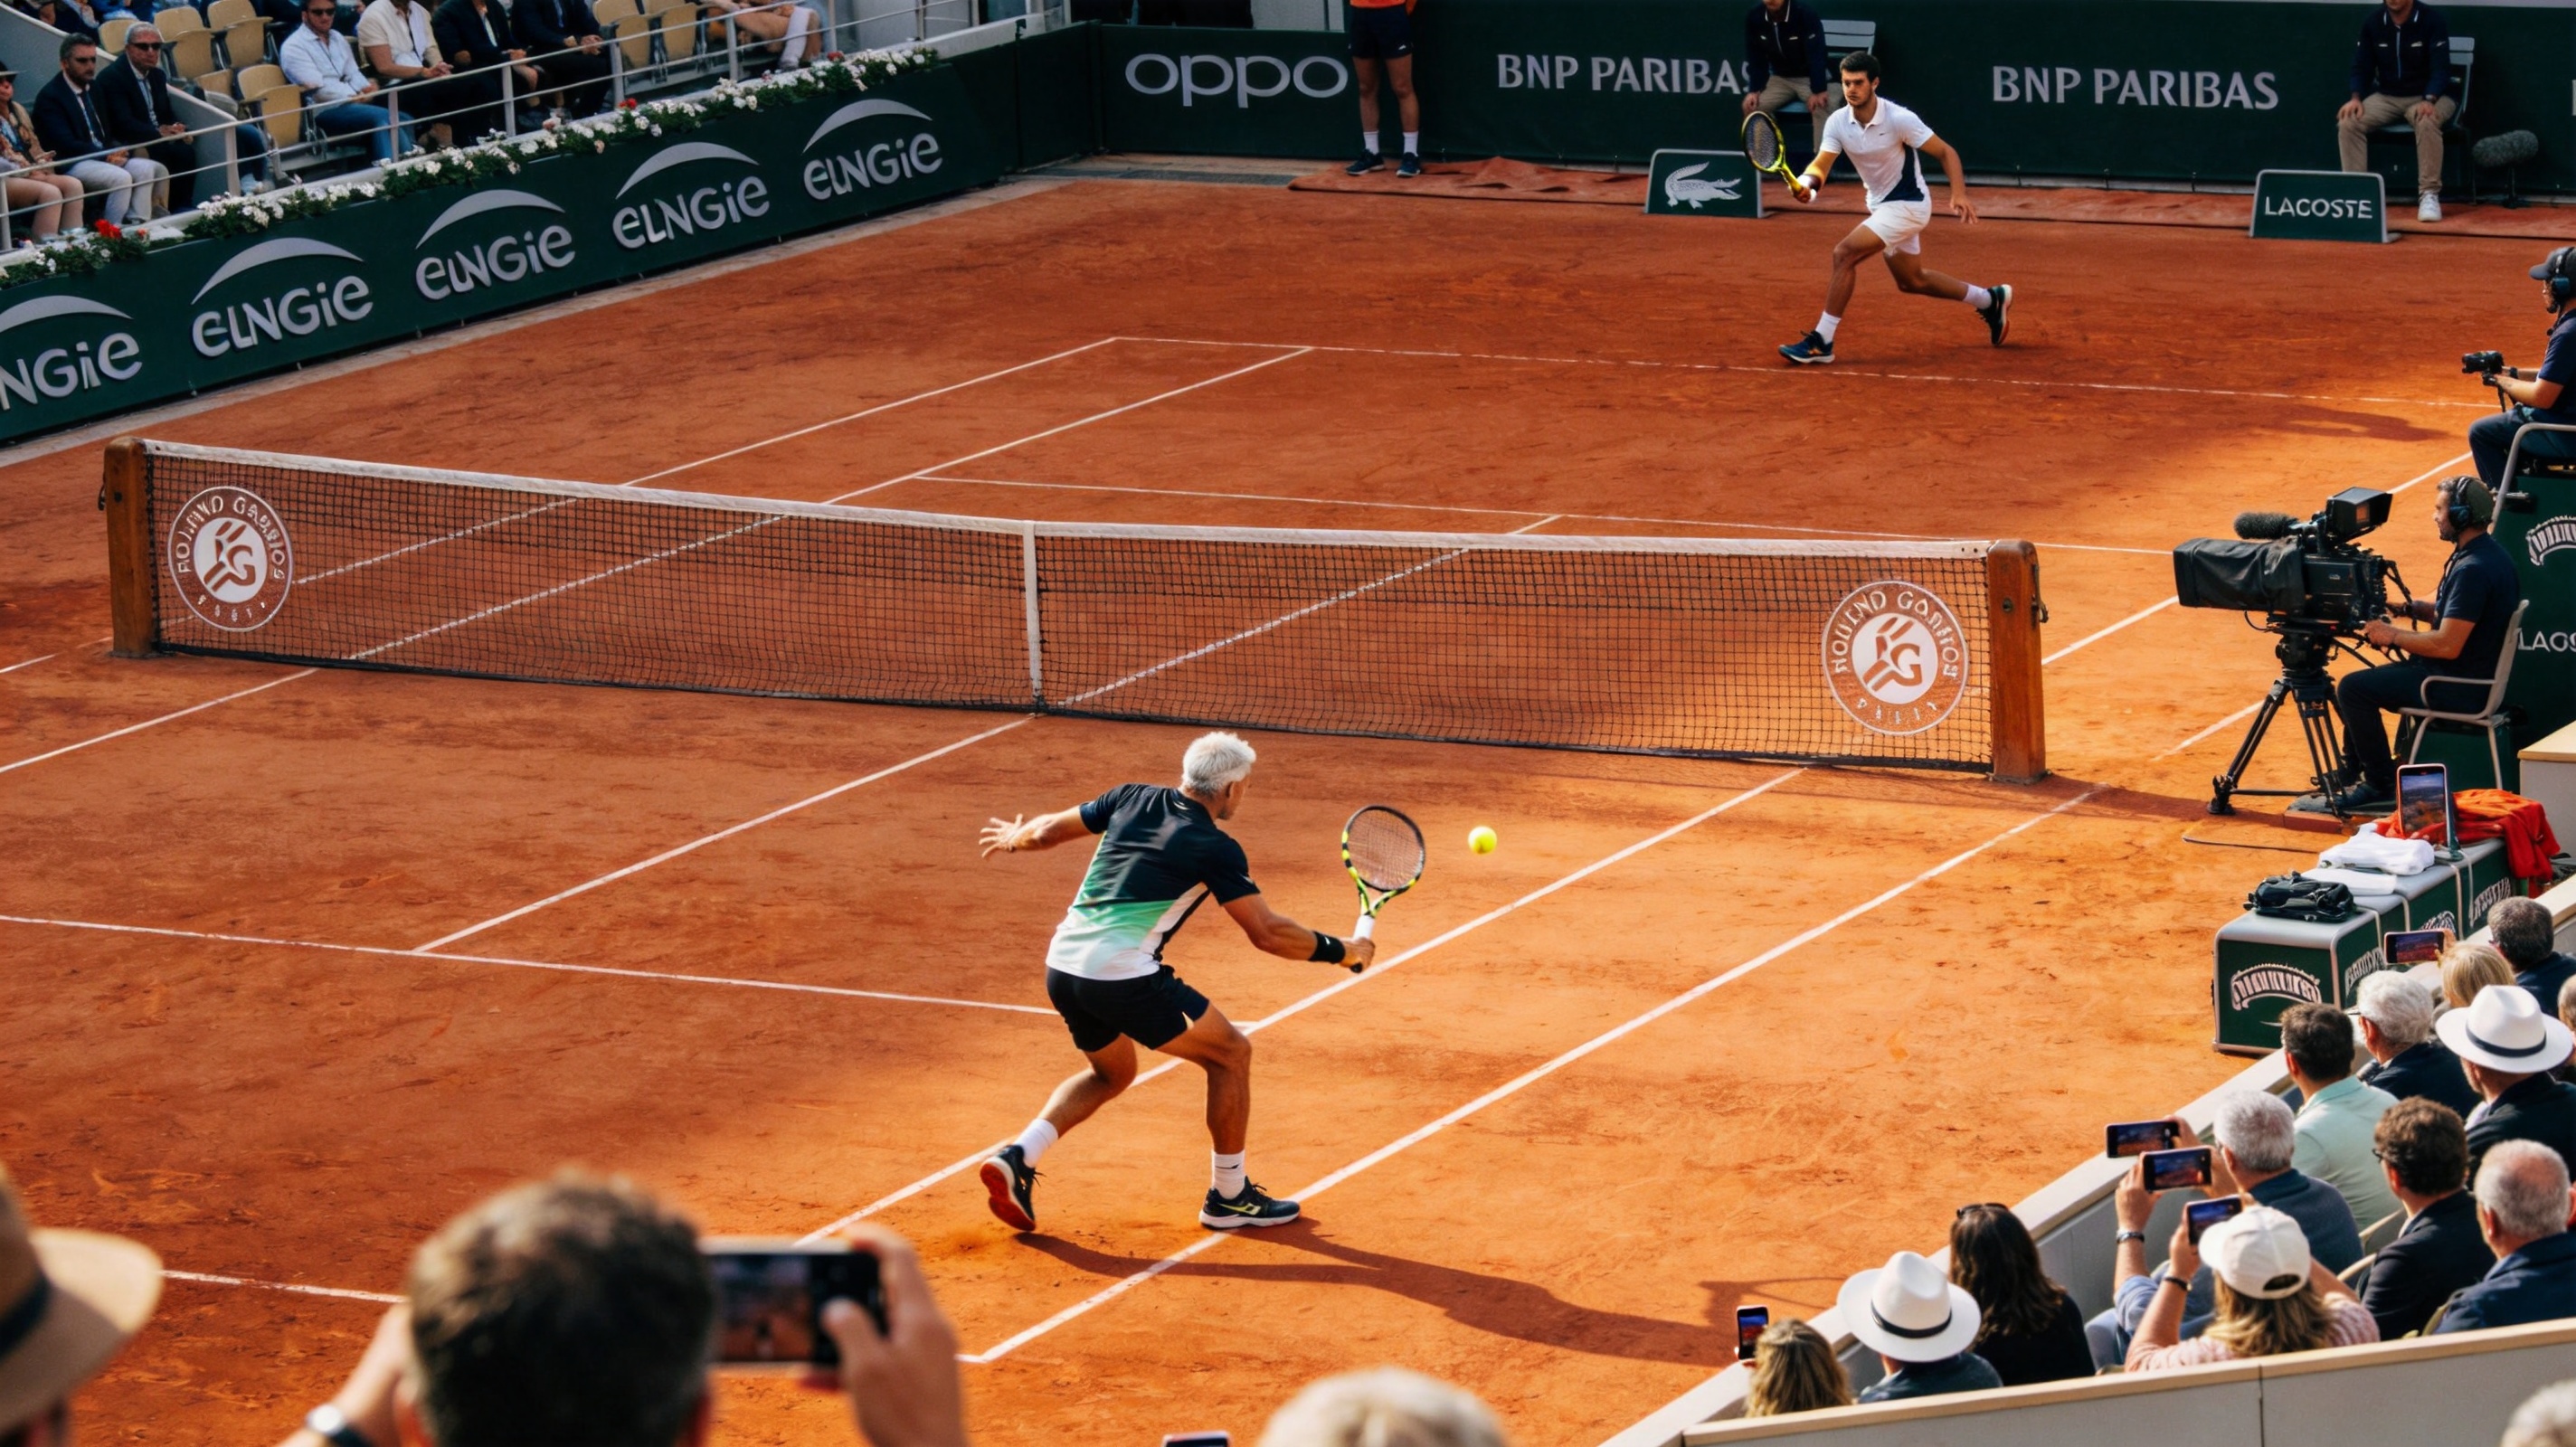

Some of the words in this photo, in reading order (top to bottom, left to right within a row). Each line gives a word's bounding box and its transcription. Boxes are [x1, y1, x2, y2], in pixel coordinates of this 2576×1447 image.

[1497, 53, 1579, 90] BNP
[1590, 56, 1750, 95] PARIBA
[1993, 65, 2081, 104] BNP
[2093, 68, 2279, 110] PARIBAS
[2264, 195, 2373, 220] LACOSTE
